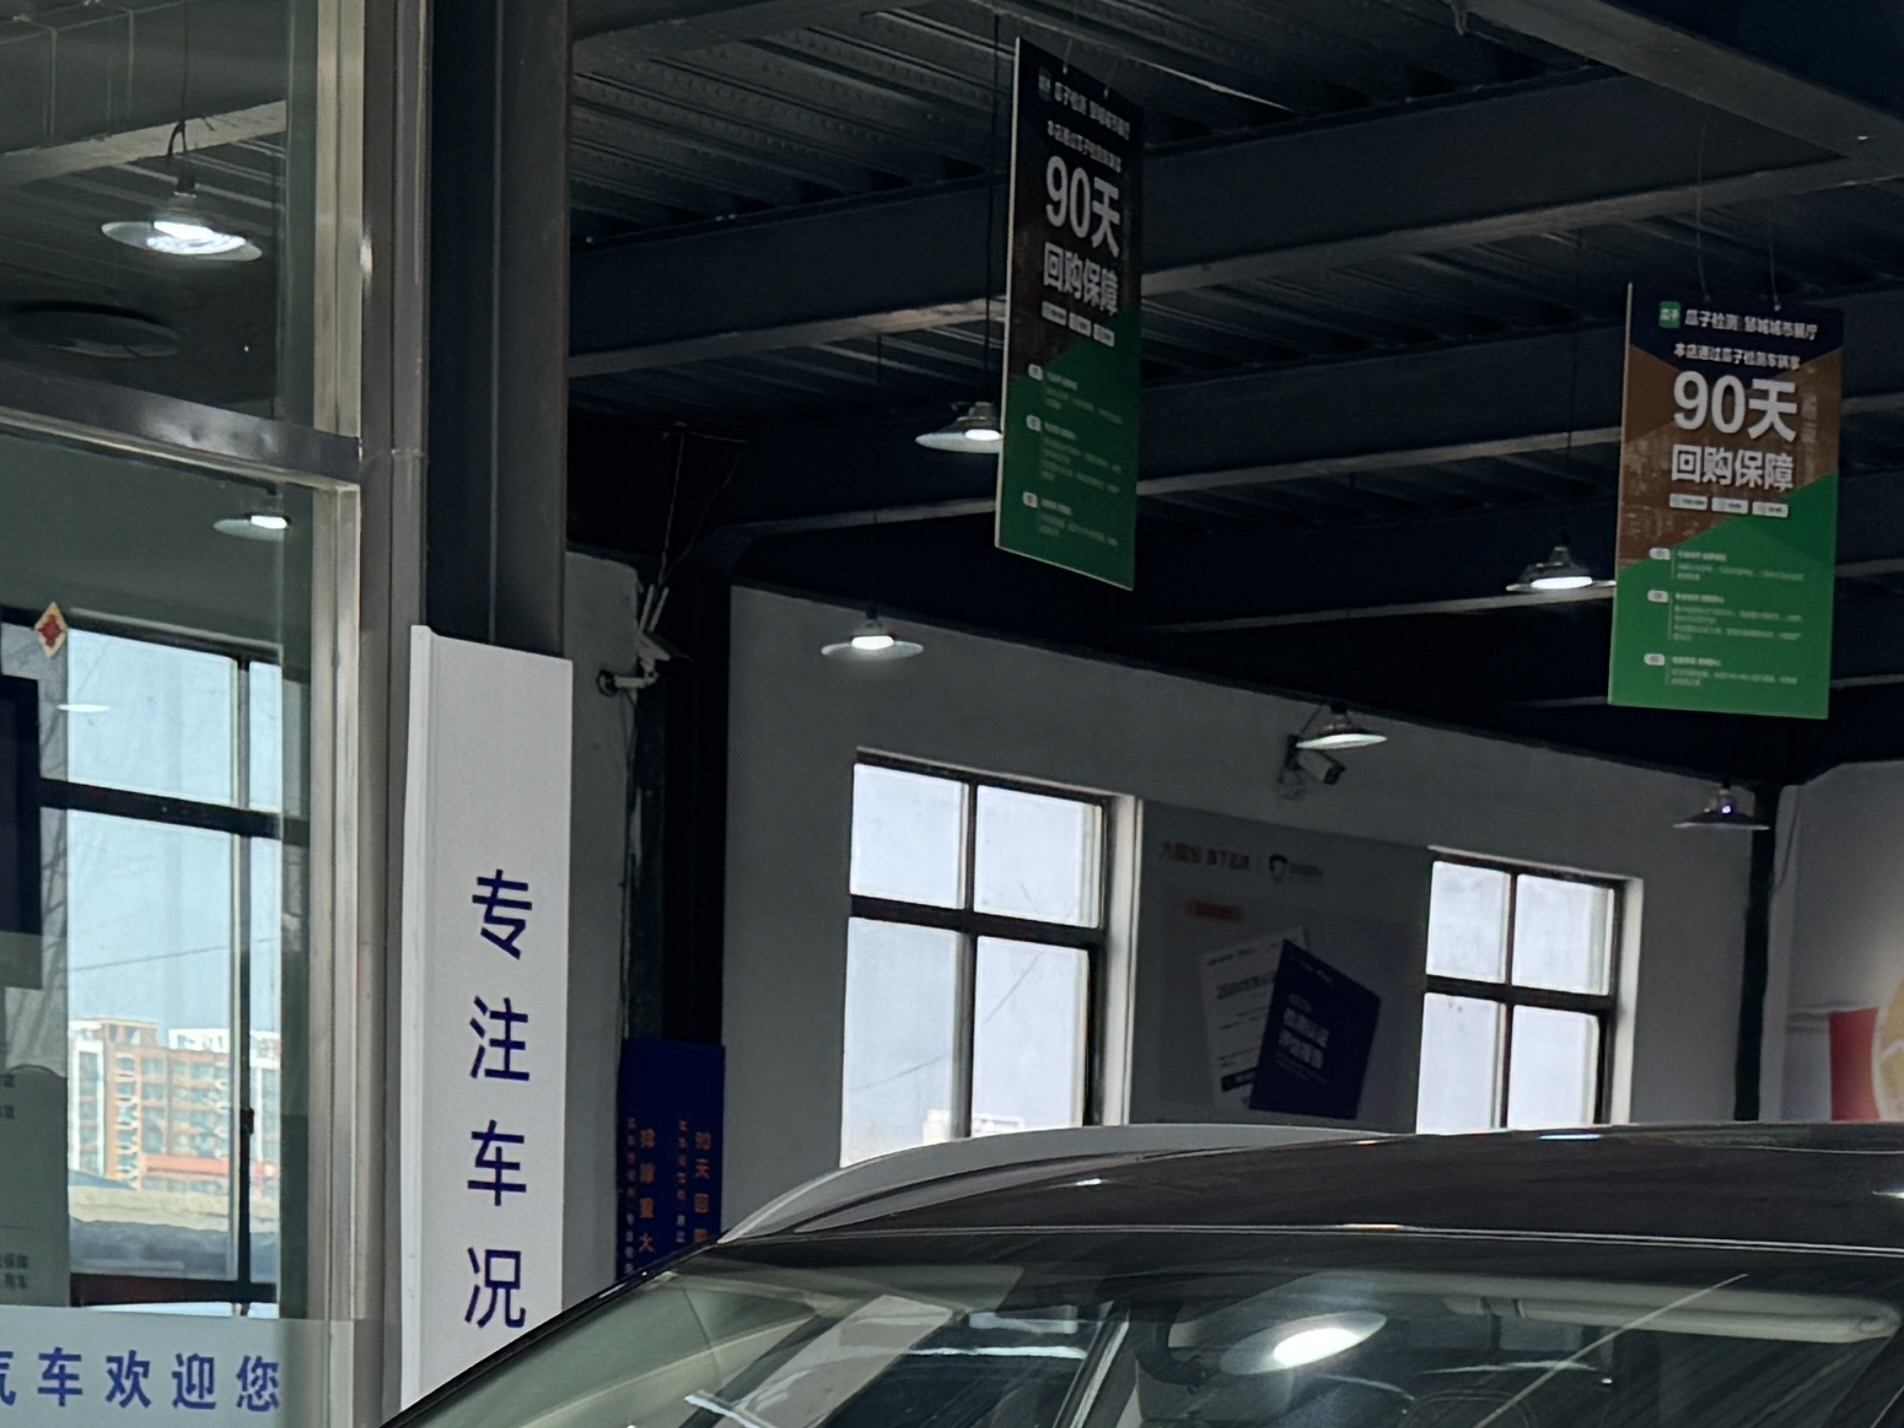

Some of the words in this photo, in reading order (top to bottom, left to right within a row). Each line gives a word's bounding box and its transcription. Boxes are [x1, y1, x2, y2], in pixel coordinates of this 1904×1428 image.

[1045, 154, 1121, 258] 90天
[1042, 241, 1119, 316] 回购保障
[1673, 370, 1798, 444] 90天
[1670, 443, 1795, 493] 回购保障
[462, 867, 535, 1330] 专注车况
